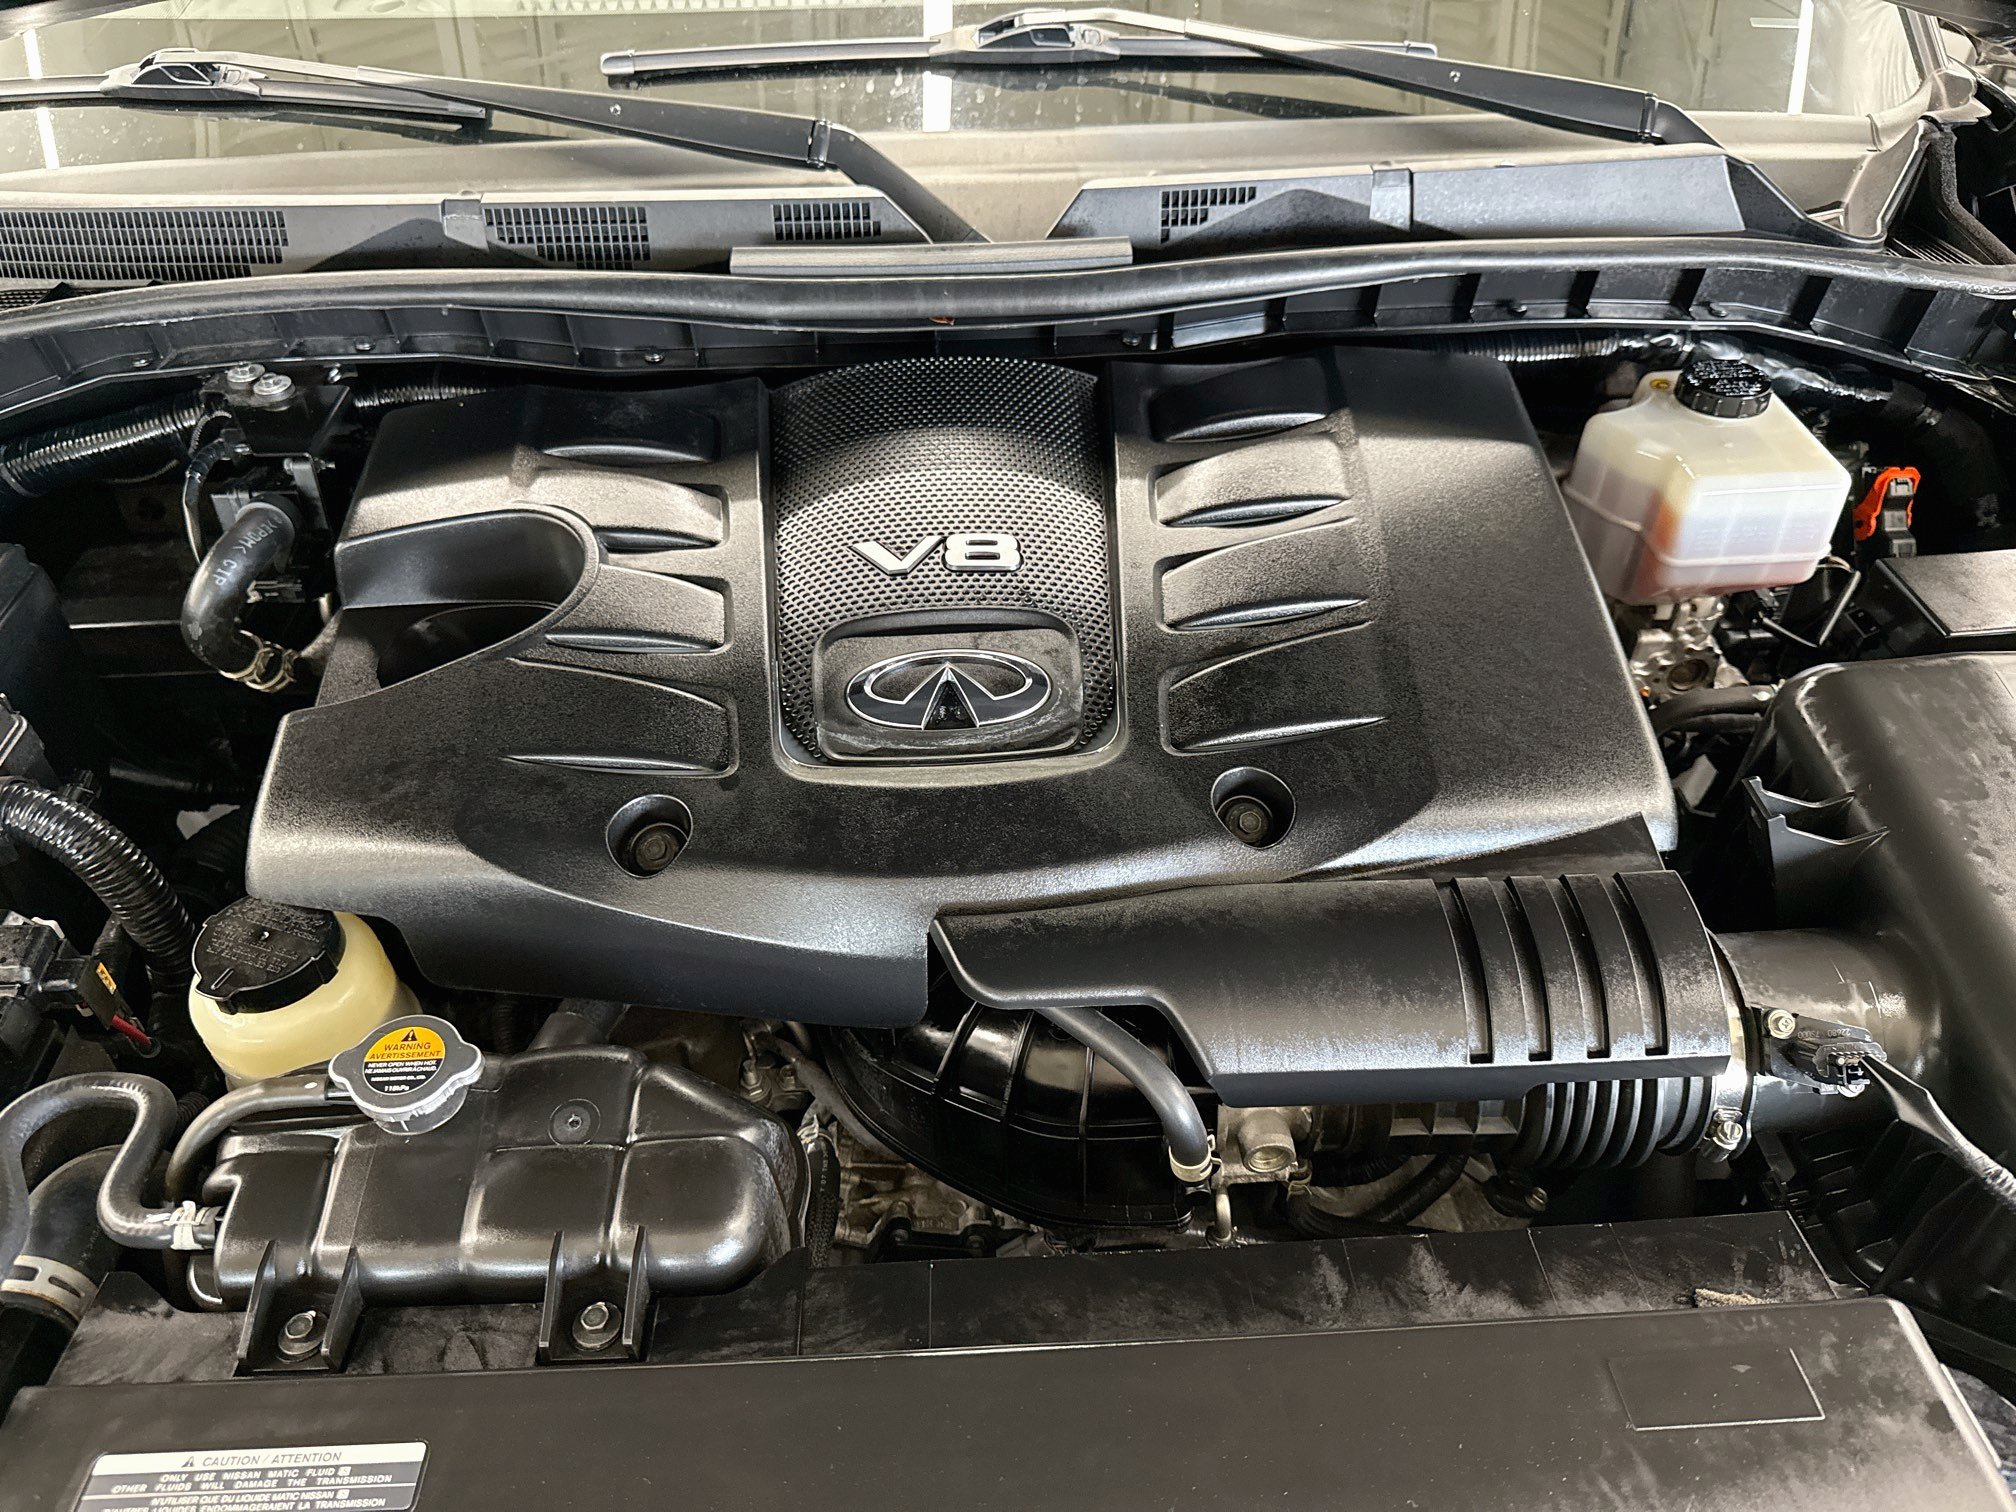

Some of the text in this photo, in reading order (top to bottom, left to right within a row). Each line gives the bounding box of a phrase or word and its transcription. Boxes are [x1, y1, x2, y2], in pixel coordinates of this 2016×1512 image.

[848, 533, 1024, 576] V8
[213, 560, 237, 586] CIP
[1827, 1027, 1851, 1037] 22680
[384, 1042, 431, 1050] WARNING
[369, 1051, 442, 1059] AVERTISSEMENT
[202, 1455, 261, 1467] CAUTION
[271, 1451, 342, 1464] ATTENTION
[160, 1473, 189, 1483] ONLY
[194, 1472, 216, 1481] USE
[222, 1471, 262, 1480] NISSAN
[267, 1469, 299, 1478] MATIC
[305, 1467, 336, 1477] FLUID
[111, 1475, 393, 1494] OTHER FLUIDS WILL DAMAGE THE TRANSMISSION
[200, 1495, 221, 1504] QUE
[221, 1495, 235, 1503] DU
[235, 1493, 271, 1503] LIQUIDE
[271, 1492, 300, 1501] MATIC
[301, 1491, 334, 1500] NISSAN
[200, 1501, 296, 1512] ENDOMMAGERAIENT
[297, 1502, 310, 1511] LA
[316, 1498, 386, 1510] TRANSMISSION
